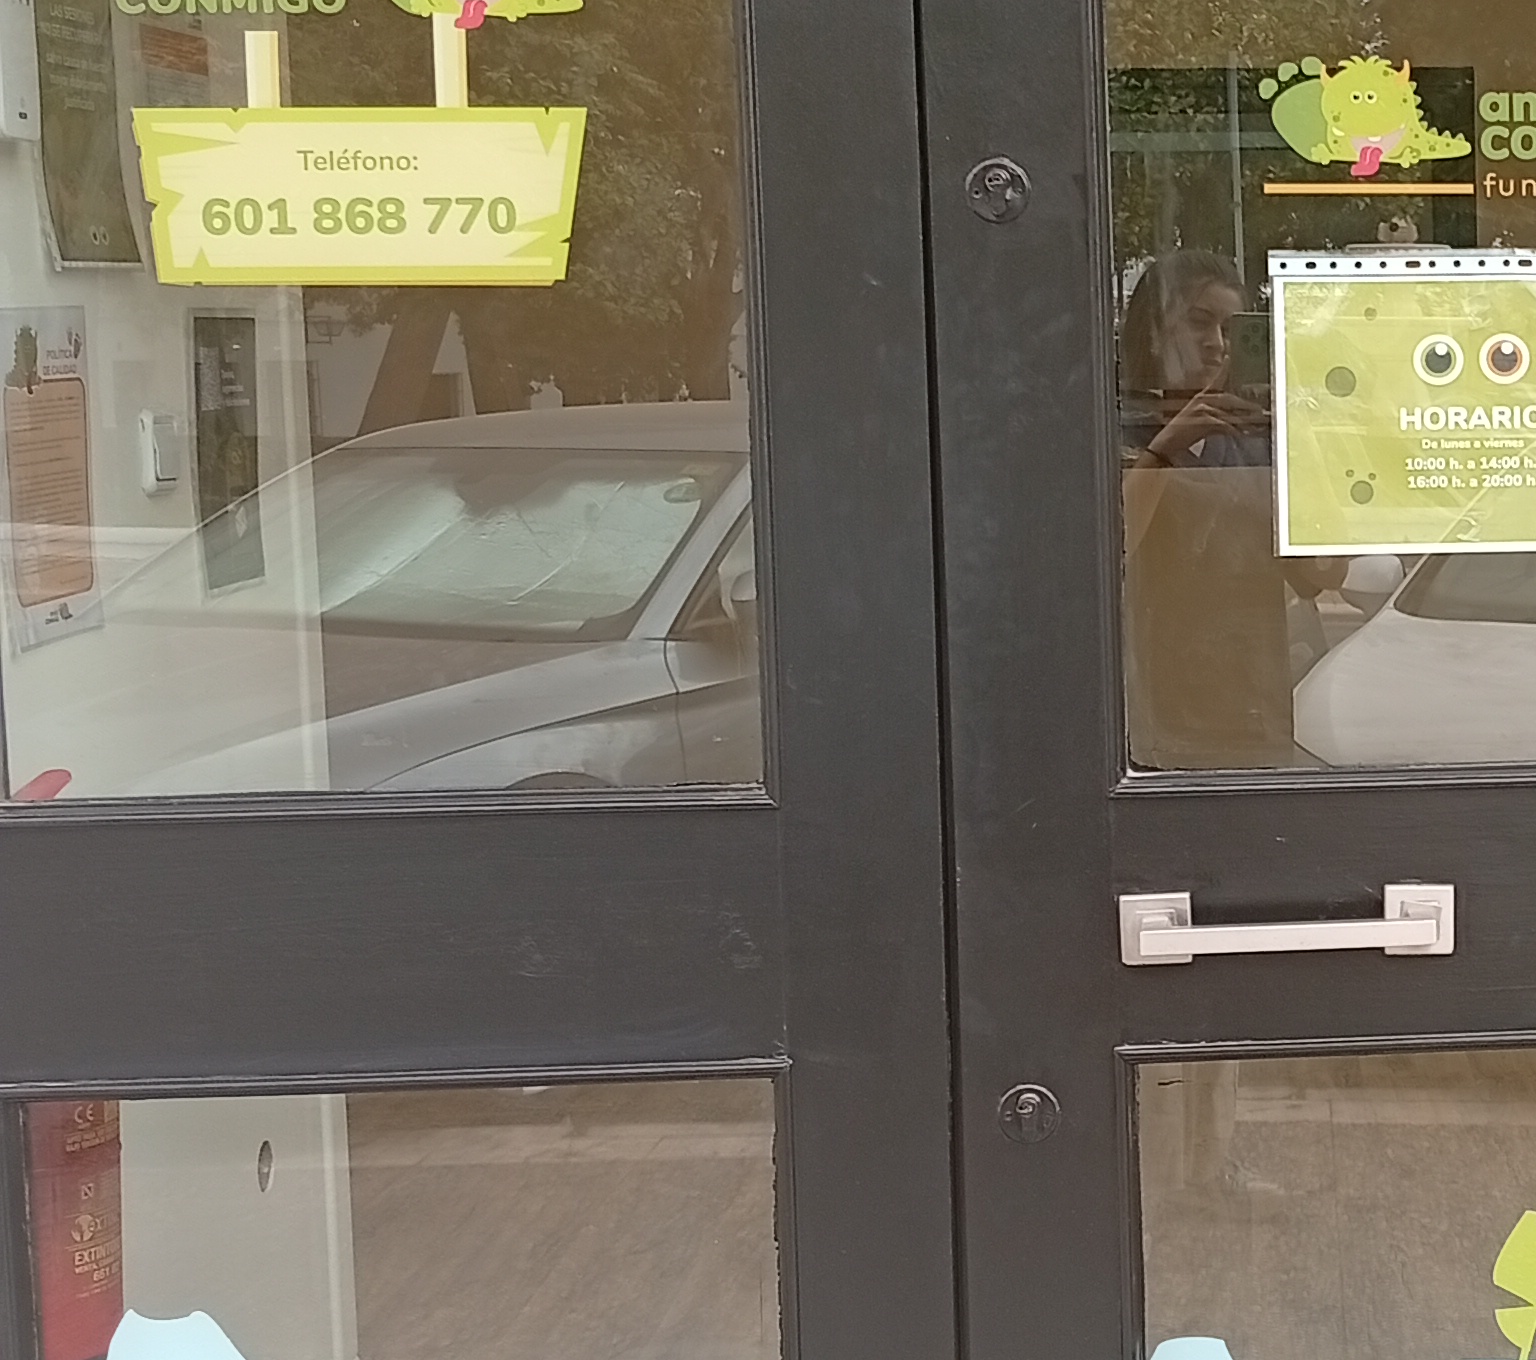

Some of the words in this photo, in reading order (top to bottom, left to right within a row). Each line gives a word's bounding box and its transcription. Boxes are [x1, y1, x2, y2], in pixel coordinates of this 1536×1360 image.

[296, 148, 420, 172] Teléfono:
[201, 196, 298, 236] 601
[312, 196, 408, 235] 868
[422, 196, 518, 235] 770
[1421, 438, 1438, 449] De
[1440, 438, 1471, 449] lunes
[1473, 441, 1481, 449] a
[1483, 437, 1525, 449] viernes
[1404, 457, 1446, 471] 10:00
[1449, 457, 1464, 470] h.
[1467, 460, 1476, 469] a
[1479, 456, 1521, 470] 14:00
[1407, 475, 1449, 489] 16:00
[1451, 475, 1466, 488] h.
[1469, 478, 1478, 487] a
[1482, 474, 1523, 487] 20:00
